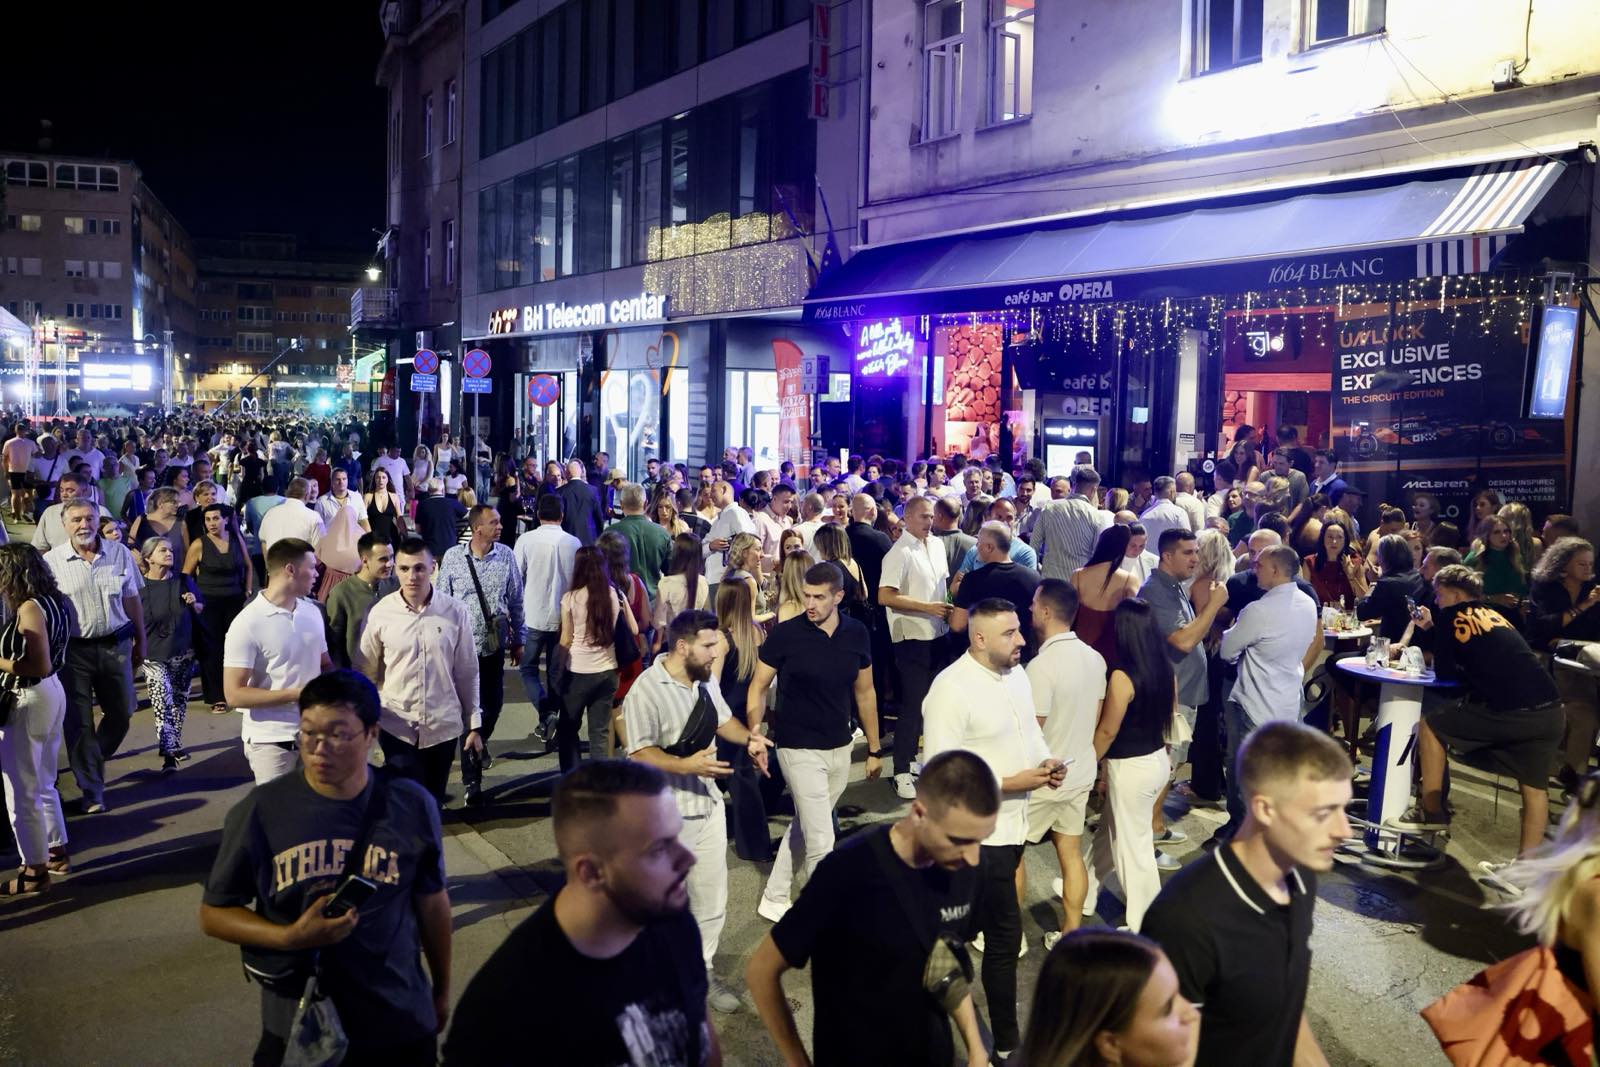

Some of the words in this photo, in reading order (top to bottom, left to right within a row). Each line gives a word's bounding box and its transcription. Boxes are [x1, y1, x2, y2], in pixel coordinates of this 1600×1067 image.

[1268, 263, 1306, 284] 1664
[1309, 257, 1384, 280] BLANC
[1004, 289, 1031, 306] café
[1032, 290, 1054, 303] bar
[1059, 280, 1113, 301] OPERA
[523, 304, 544, 331] BH
[545, 302, 606, 329] Telecom
[610, 292, 666, 323] centar
[814, 307, 834, 319] 1664
[833, 304, 866, 317] BLANC
[1249, 331, 1284, 357] glo
[1342, 396, 1360, 405] THE
[1362, 392, 1401, 404] CIRCUIT
[1403, 389, 1445, 400] EDITION
[1402, 480, 1469, 489] McLaren
[1488, 479, 1517, 487] DESIGN
[1518, 478, 1555, 487] INSPIRED
